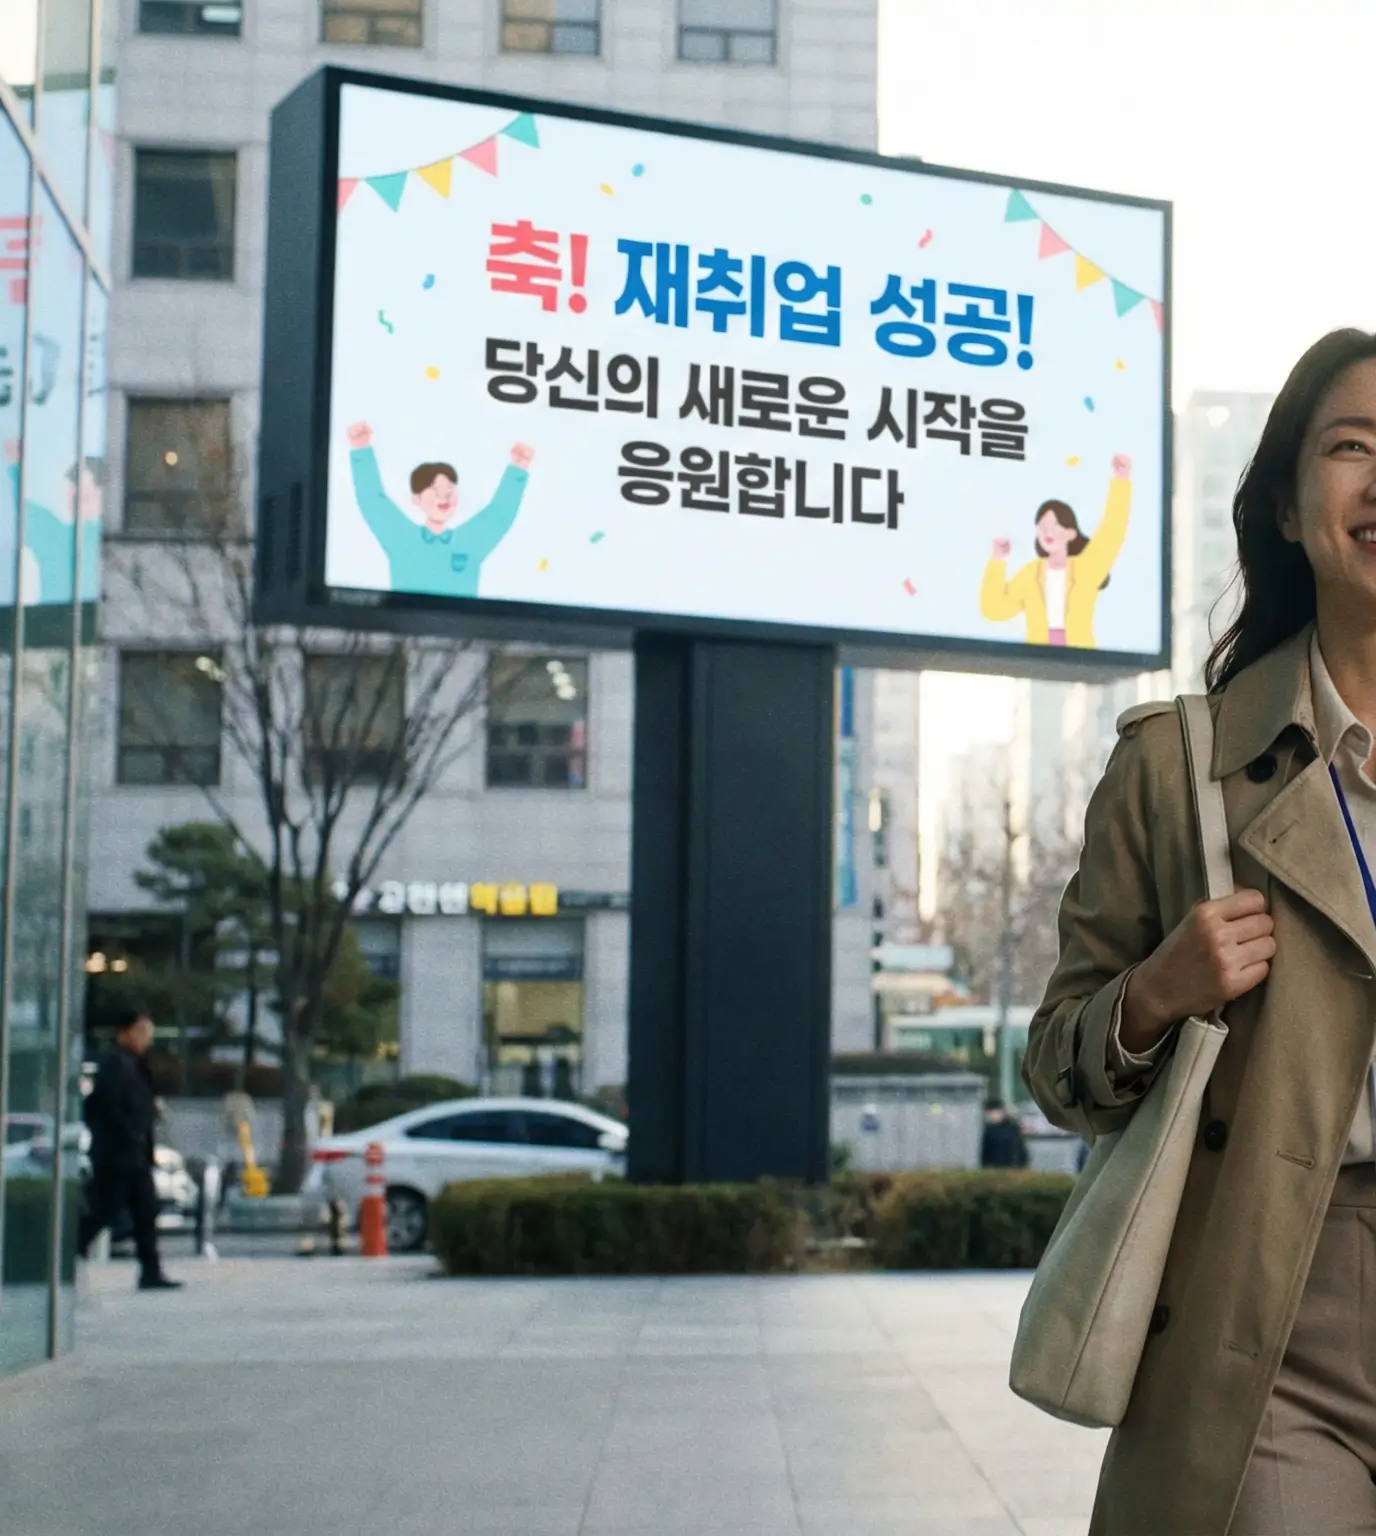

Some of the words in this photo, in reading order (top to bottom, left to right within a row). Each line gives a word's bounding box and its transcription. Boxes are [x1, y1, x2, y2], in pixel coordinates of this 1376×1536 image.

[487, 221, 588, 312] 축!
[614, 239, 842, 347] 재취업
[869, 274, 1035, 370] 성공!
[485, 338, 659, 418] 당신의
[679, 364, 849, 440] 새로운
[867, 387, 1029, 460] 시작을
[617, 440, 905, 530] 응원합니다
